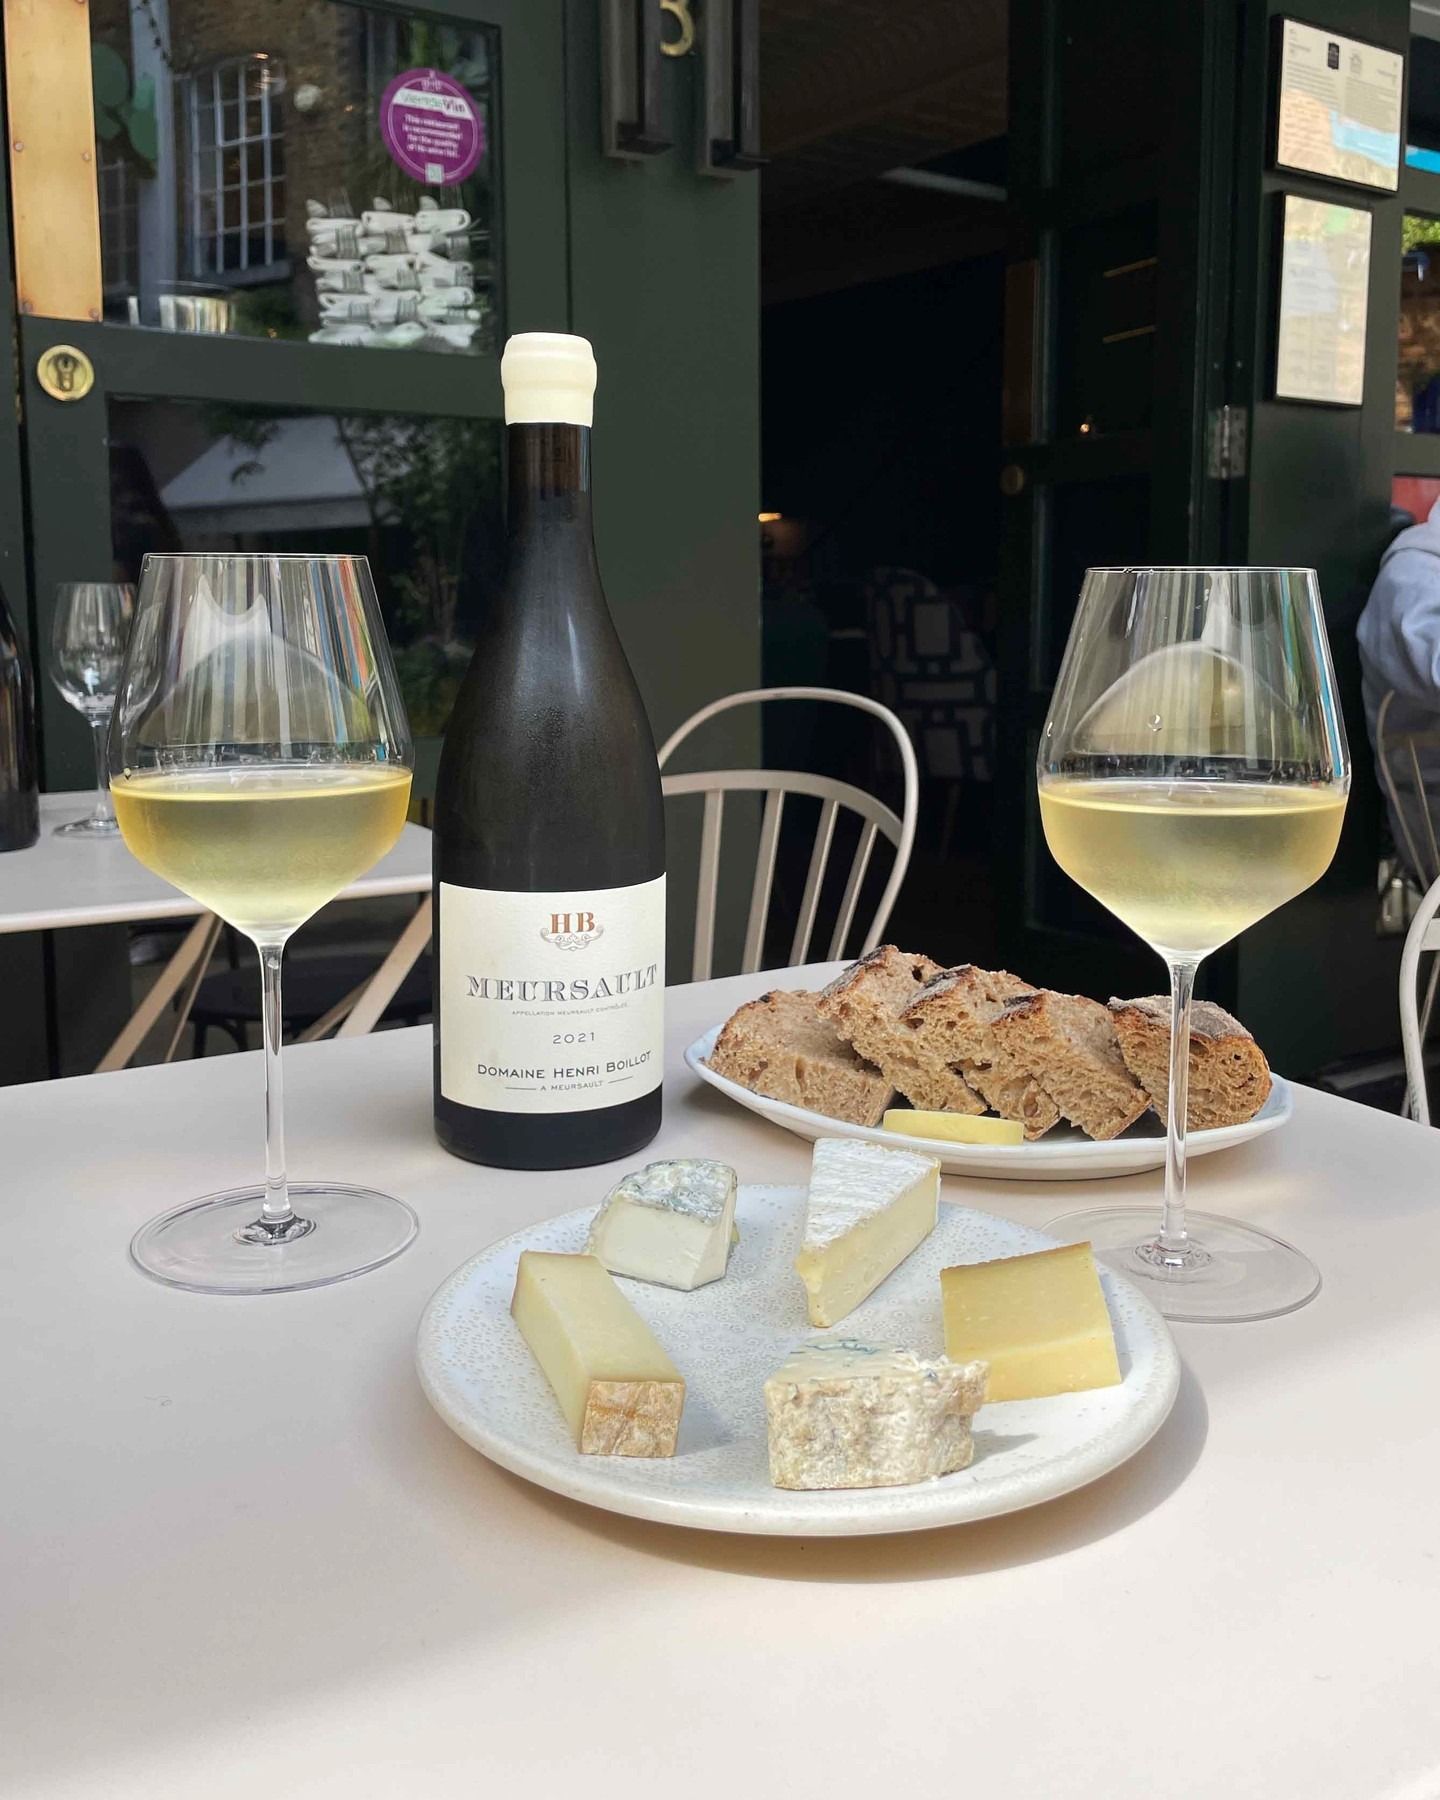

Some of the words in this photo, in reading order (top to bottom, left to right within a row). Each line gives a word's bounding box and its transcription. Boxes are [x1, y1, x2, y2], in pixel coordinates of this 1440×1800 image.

[466, 963, 657, 1001] MEURSAULT
[557, 1008, 594, 1016] MEURSAULT
[552, 1032, 595, 1044] 2021
[477, 1063, 545, 1080] DOMAINE
[553, 1065, 600, 1079] HENRI
[606, 1050, 652, 1073] BOILLOT
[551, 1080, 603, 1091] MEURSAULT
